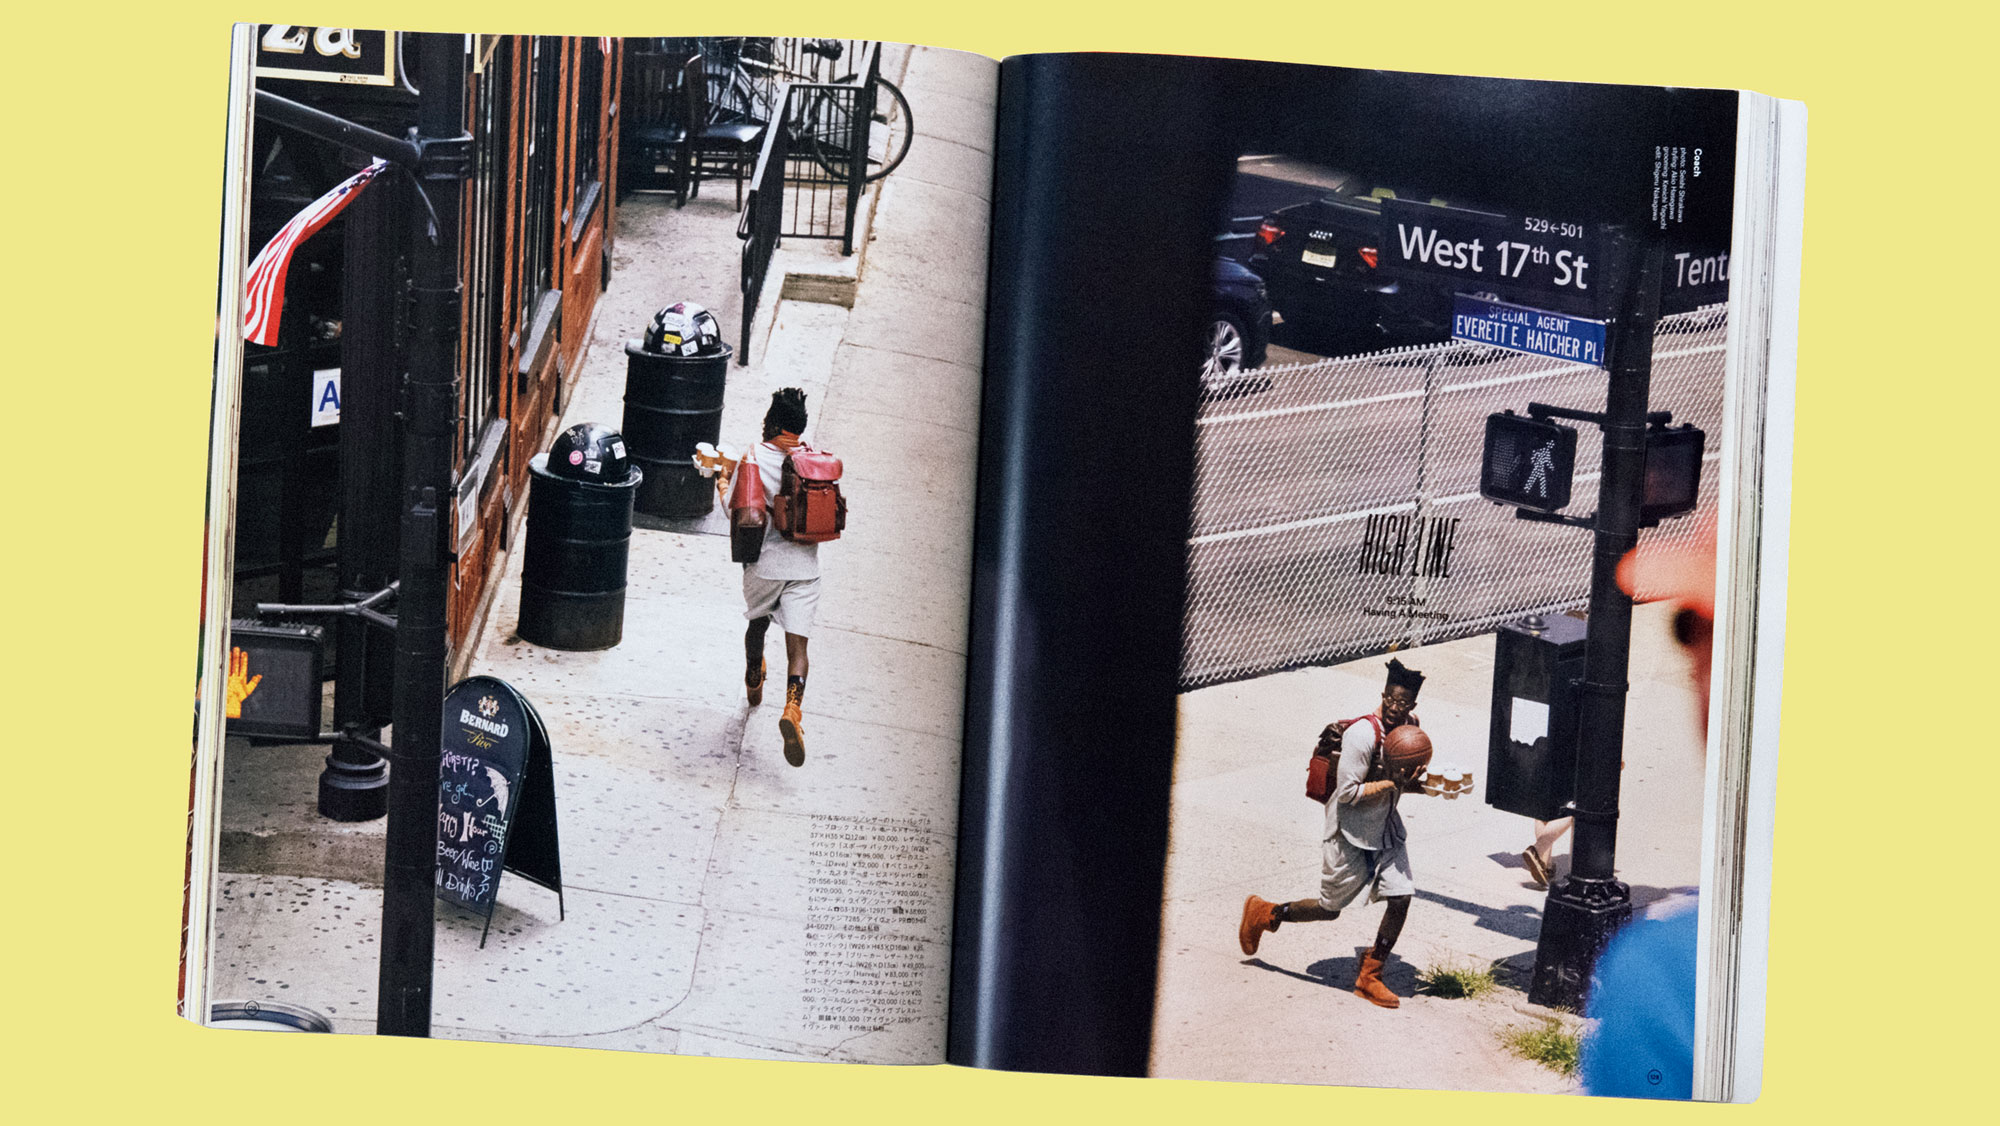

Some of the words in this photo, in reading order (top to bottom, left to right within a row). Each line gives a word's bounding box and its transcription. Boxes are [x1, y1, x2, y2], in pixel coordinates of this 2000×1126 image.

[1693, 148, 1703, 178] Coach
[1398, 223, 1484, 273] West
[1496, 240, 1550, 278] 17th
[1553, 249, 1589, 289] St
[1674, 249, 1731, 288] Tent
[1488, 305, 1531, 327] SPECIAL
[1536, 315, 1571, 334] AGENT
[1456, 314, 1508, 344] EVERETT
[1511, 326, 1522, 348] E.
[1526, 329, 1581, 359] HATCHER
[1584, 340, 1600, 363] PL
[318, 380, 341, 412] A
[1358, 513, 1411, 576] HIGH
[1411, 516, 1461, 579] LINE
[1363, 607, 1396, 619] Having
[1399, 608, 1406, 617] A
[1408, 609, 1449, 621] Meeting
[1409, 597, 1426, 607] AM
[460, 708, 509, 738] BERNARD
[459, 811, 488, 842] Hour
[445, 873, 476, 900] Drinks
